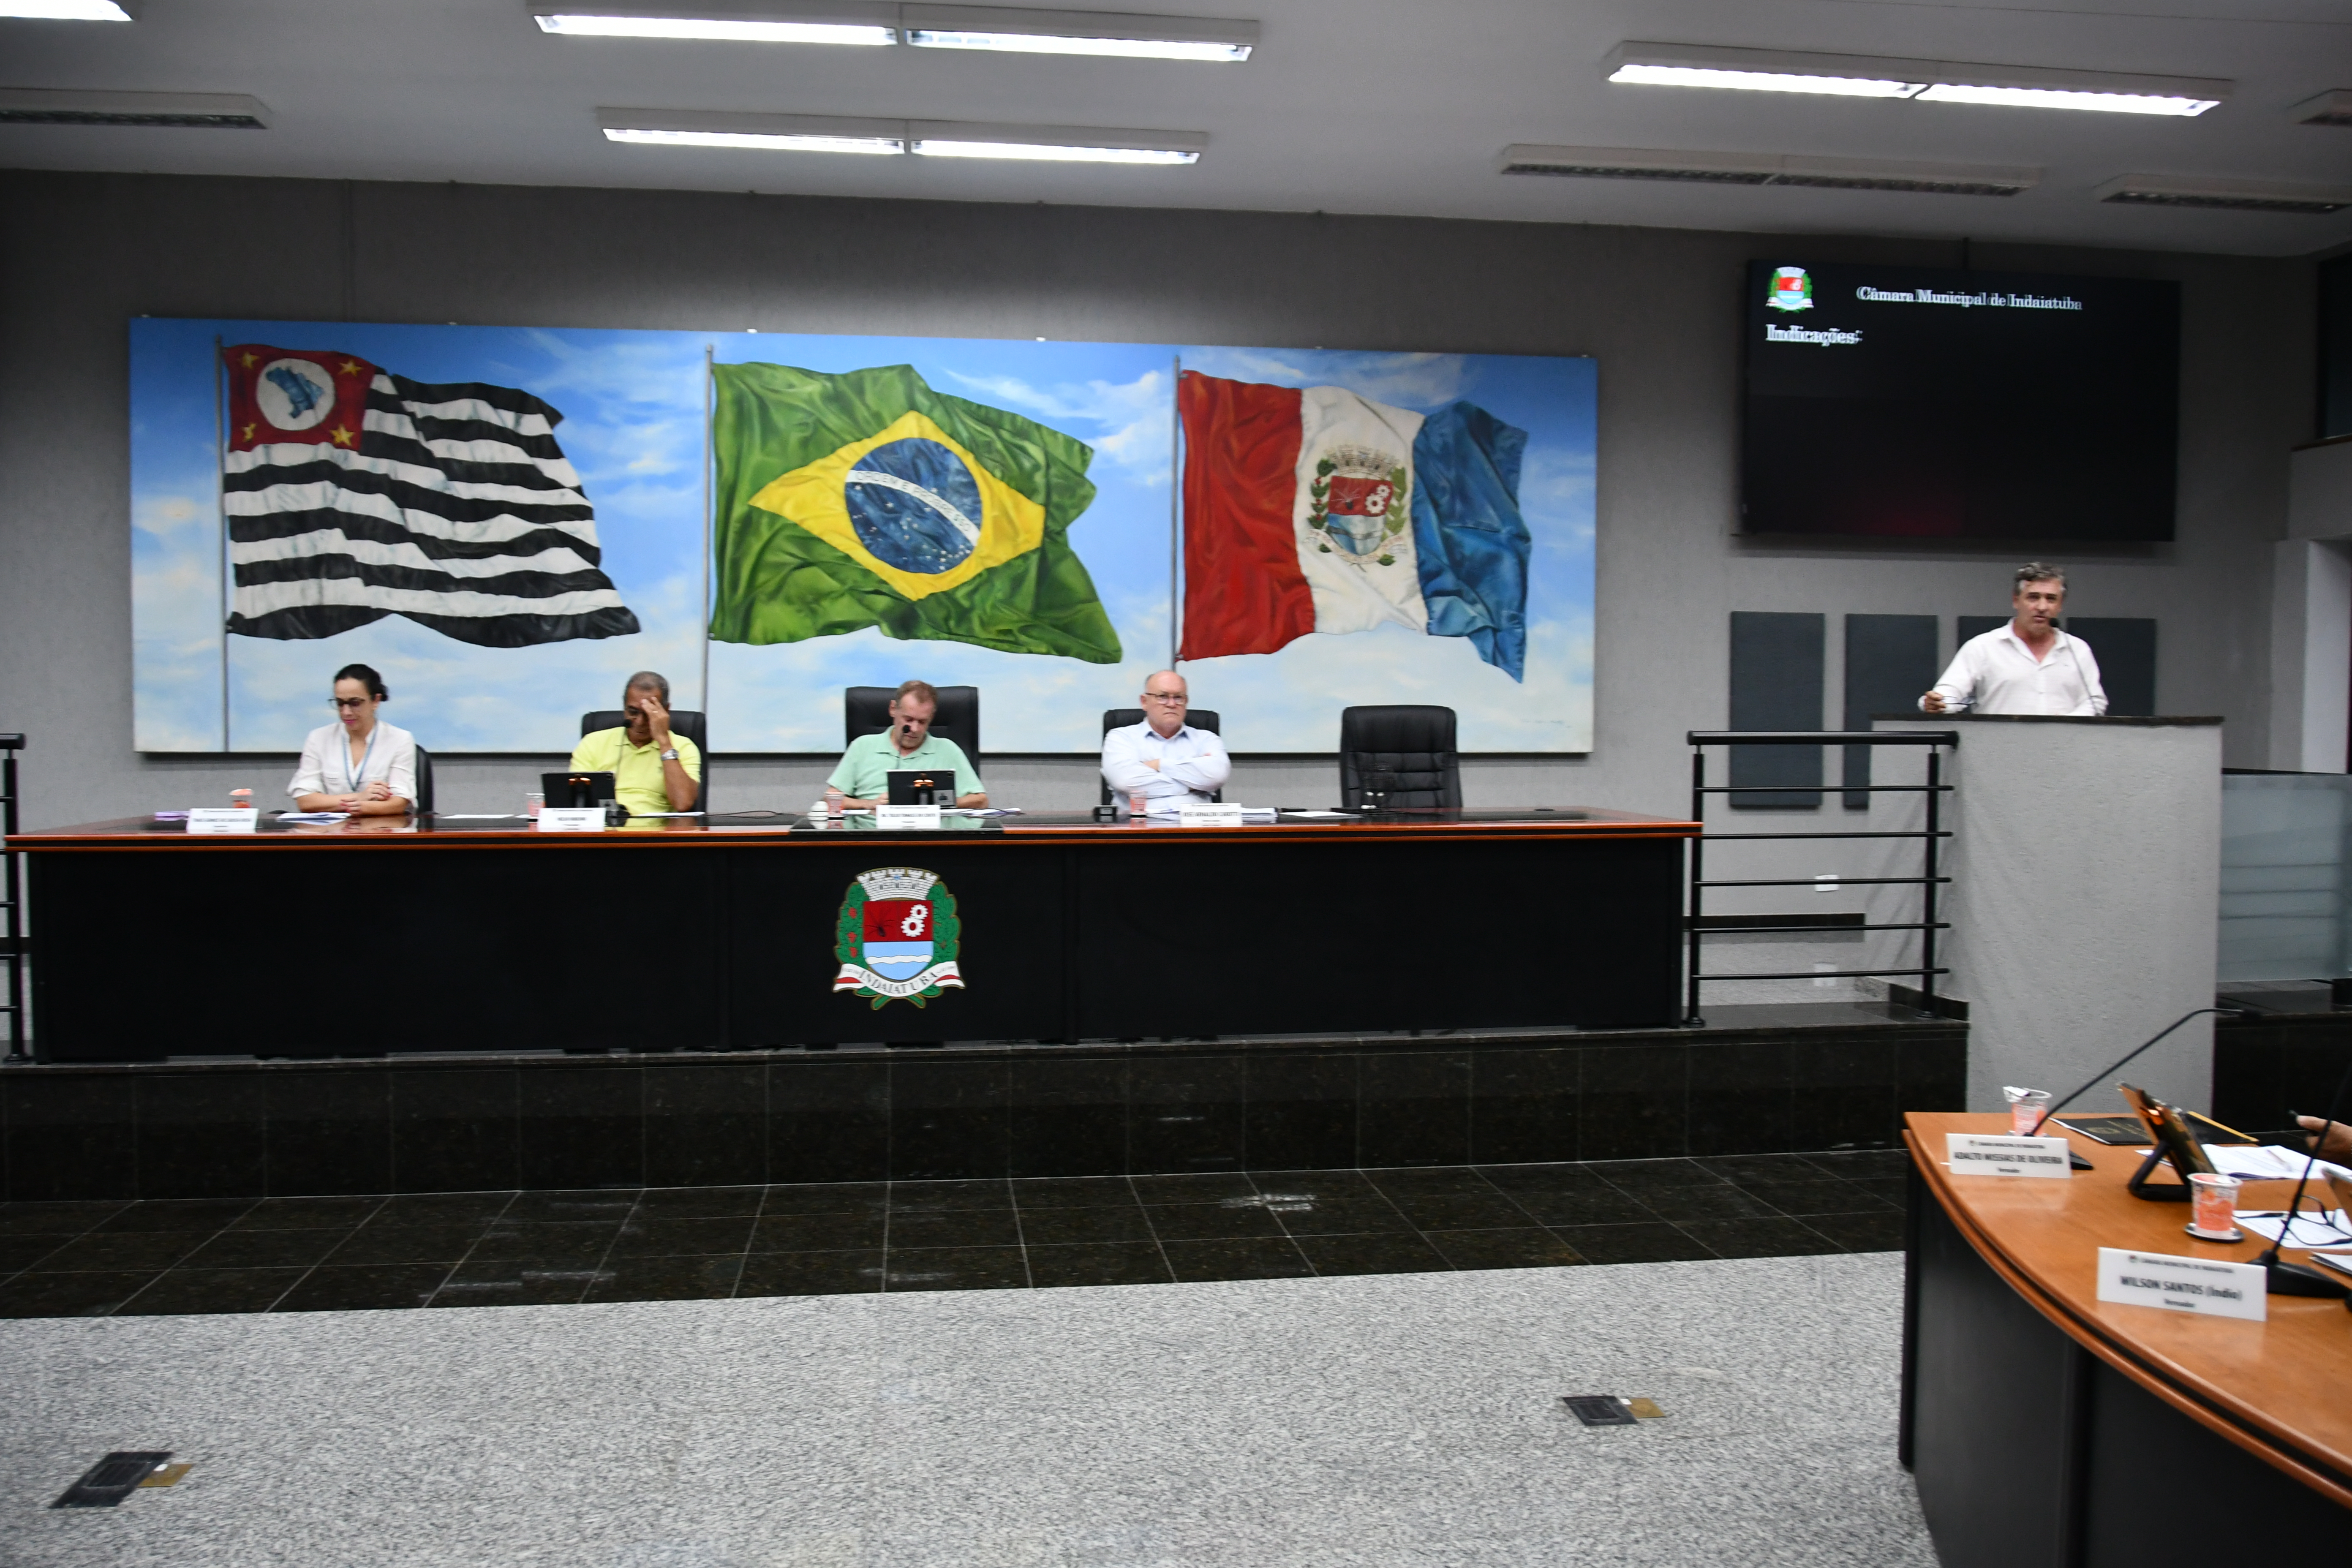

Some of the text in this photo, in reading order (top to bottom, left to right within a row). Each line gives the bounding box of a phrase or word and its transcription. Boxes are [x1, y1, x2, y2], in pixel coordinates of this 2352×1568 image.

[1857, 286, 2082, 310] Câmara Municipal de Indaiatuba
[1765, 324, 1863, 346] Indicações:
[2121, 1276, 2161, 1289] WILSON
[2163, 1281, 2203, 1295] SANTOS
